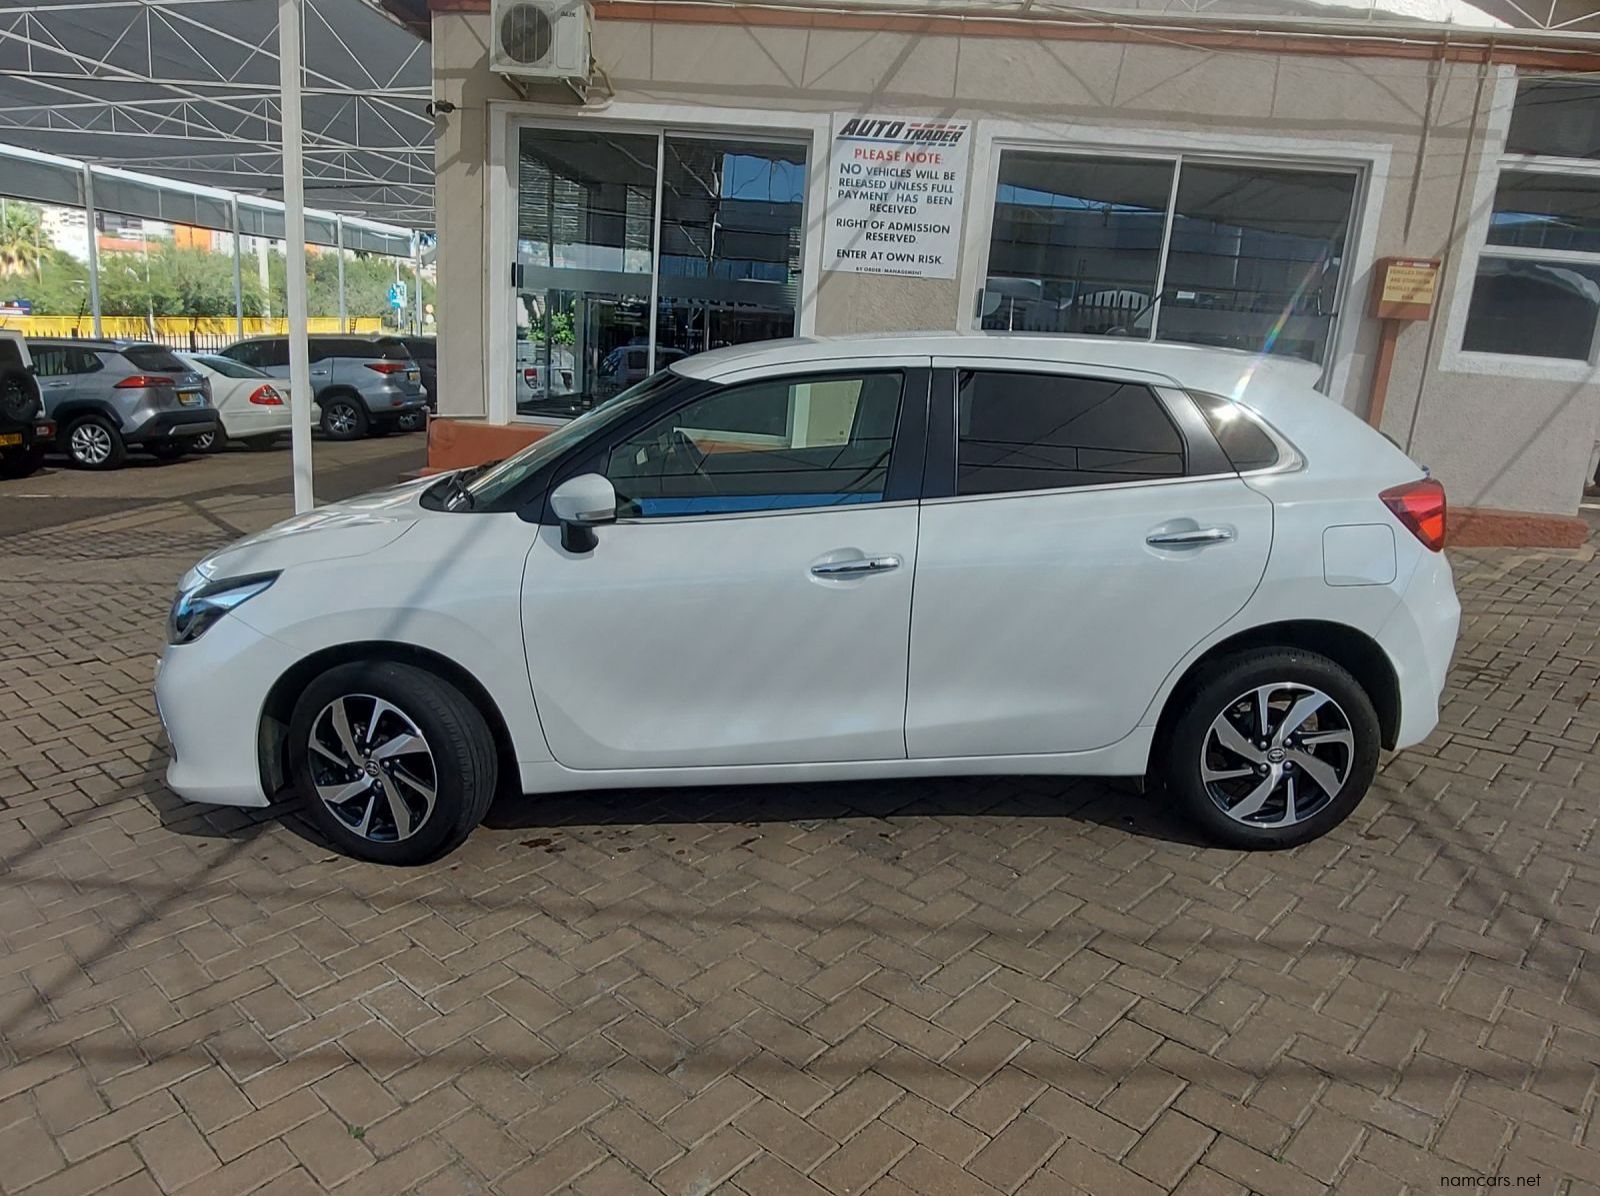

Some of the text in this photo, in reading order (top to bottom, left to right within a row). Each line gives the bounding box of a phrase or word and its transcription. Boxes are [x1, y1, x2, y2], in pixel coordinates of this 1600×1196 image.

[839, 119, 964, 142] AUTO TRADER
[854, 148, 901, 161] PLEASE
[840, 163, 955, 180] NO VEHICLES WILL BE
[839, 178, 954, 193] RELEASED UNLESS FULL
[838, 190, 952, 205] PAYMENT HAS BEEN
[836, 219, 950, 234] RIGHT OF ADMISSION
[837, 249, 866, 259] ENTER
[871, 251, 884, 260] AT
[886, 252, 914, 262] OWN
[883, 268, 923, 276] MANAGEMENT
